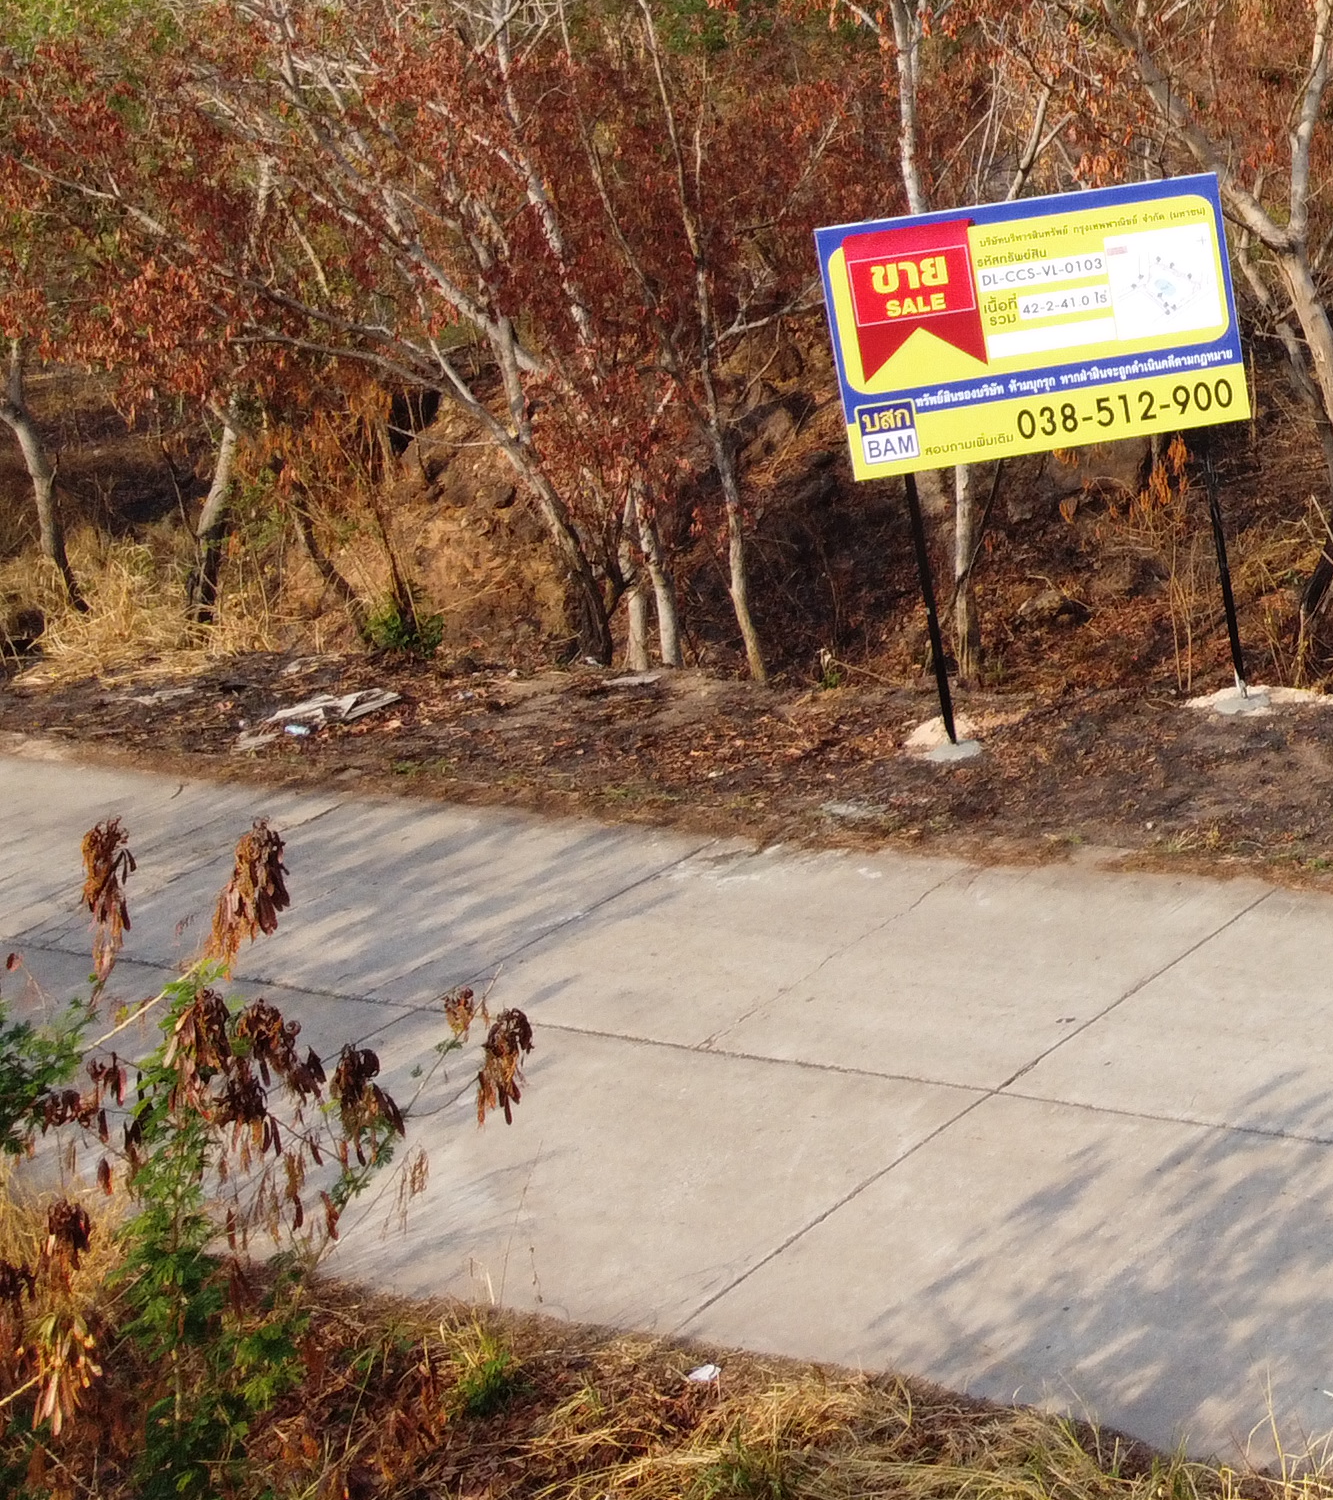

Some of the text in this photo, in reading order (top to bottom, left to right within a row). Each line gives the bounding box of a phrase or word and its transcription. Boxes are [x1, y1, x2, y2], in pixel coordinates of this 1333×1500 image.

[1142, 212, 1166, 223] จำกัด
[1169, 207, 1206, 221] (มหาชน)
[977, 248, 1047, 268] รหัสทรัพย์สิน
[870, 255, 949, 294] ขาย
[982, 258, 1103, 287] DL-CCS-VL-0103
[885, 292, 947, 317] SALE
[984, 293, 1018, 314] เนื้อที่
[1022, 290, 1108, 315] 42-2-41.0 ไร่
[989, 313, 1017, 326] รวม
[915, 383, 1005, 408] ทรัพย์สินของบริษัท
[1008, 376, 1056, 394] ห้ามบุกรุก
[861, 408, 911, 433] บสก
[925, 378, 1233, 456] สอบถามเพิ่มเติม 038-512-900
[867, 434, 915, 459] BAM
